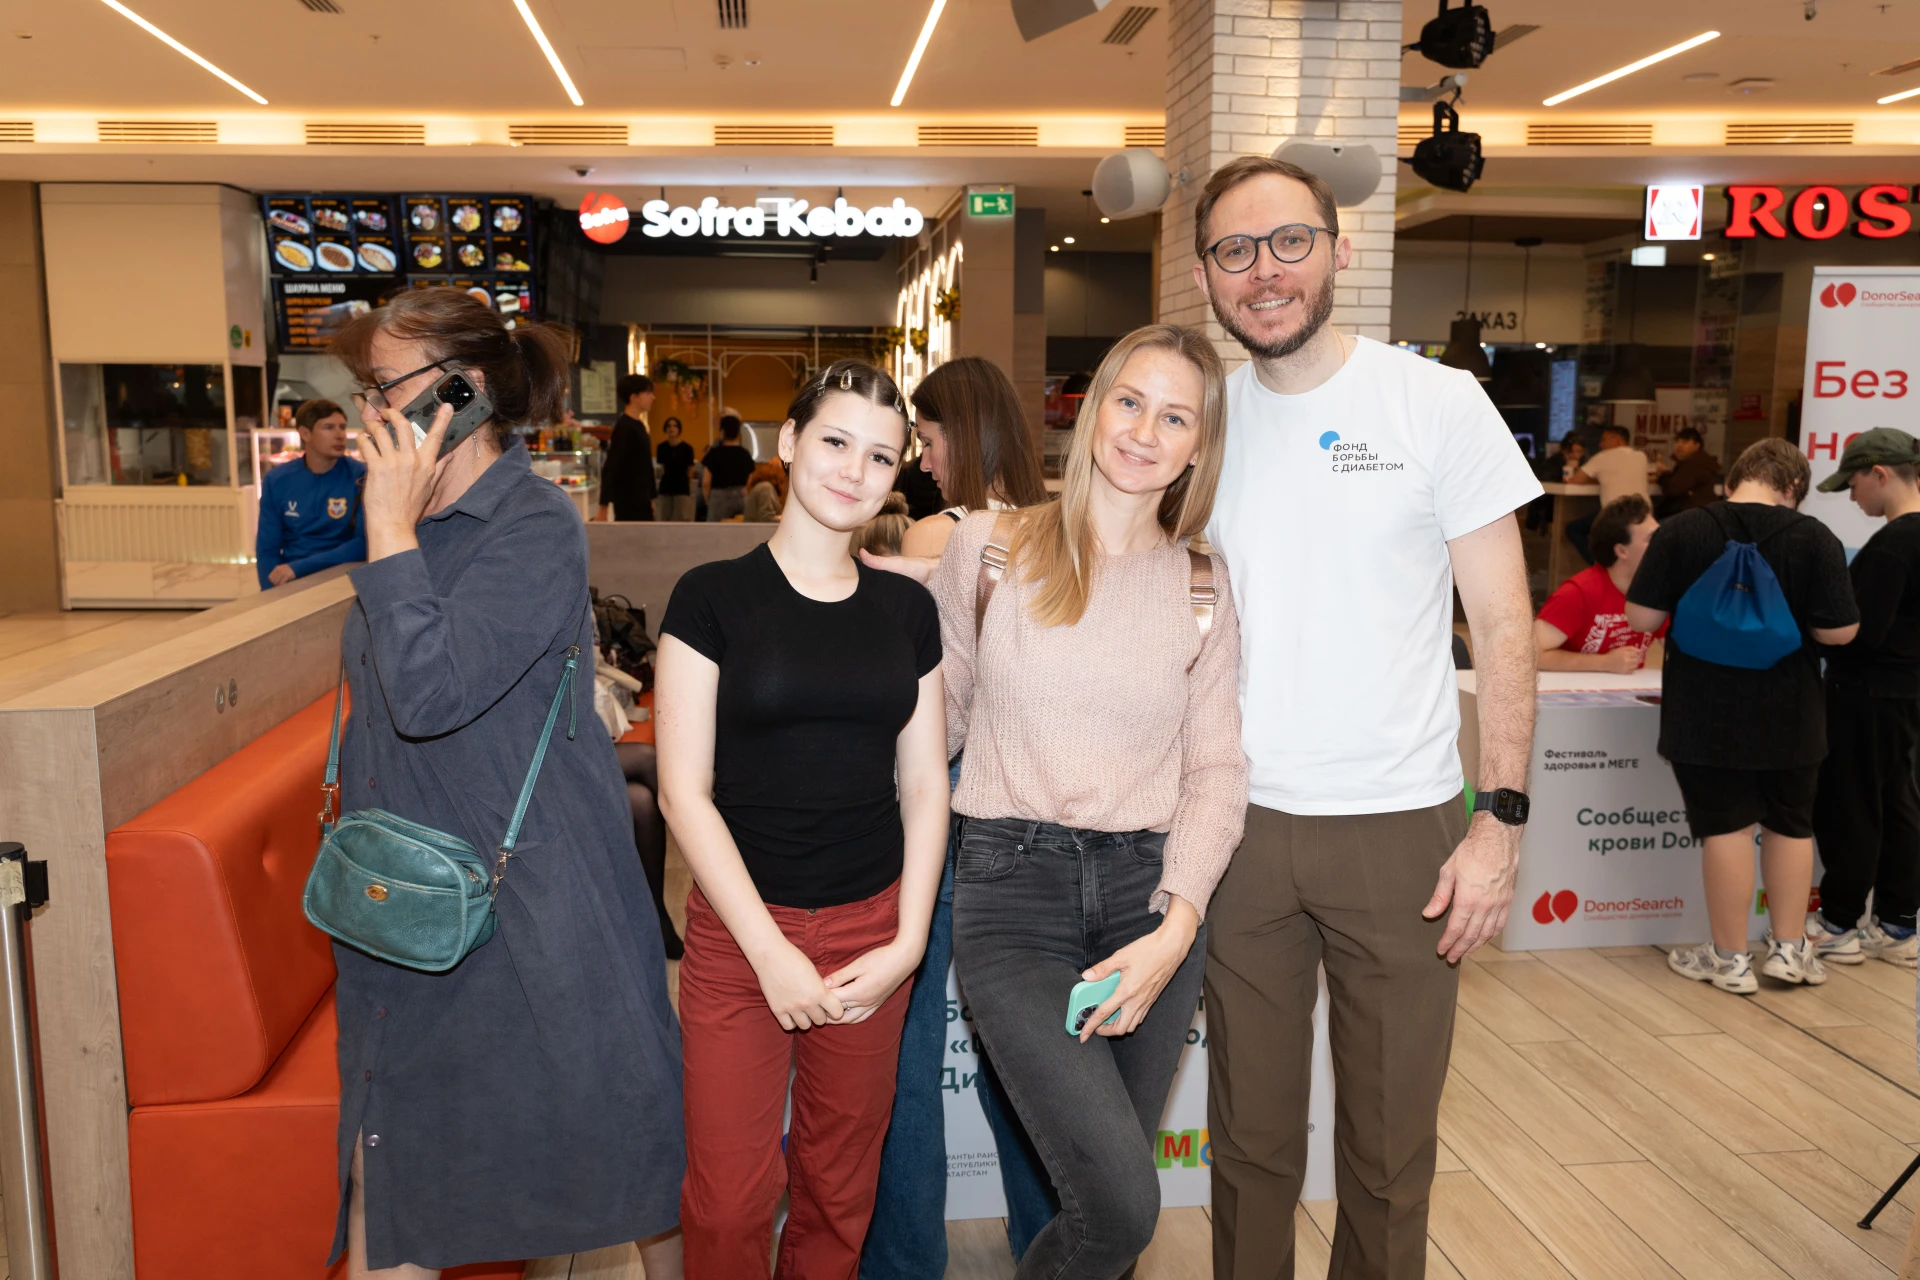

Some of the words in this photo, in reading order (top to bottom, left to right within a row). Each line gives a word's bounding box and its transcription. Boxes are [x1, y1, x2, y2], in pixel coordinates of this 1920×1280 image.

[579, 205, 629, 231] Sofra
[642, 197, 766, 238] Sofra
[776, 197, 925, 238] Kebab
[1725, 185, 1920, 239] ROS
[1813, 361, 1909, 399] Без
[1333, 443, 1368, 452] ФОНД
[1332, 453, 1378, 462] БОРЬБЫ
[1332, 464, 1339, 472] С
[1341, 463, 1404, 473] ДИАБЕТОМ
[1544, 749, 1608, 758] Фестиваль
[1543, 762, 1597, 771] здоровья
[1608, 759, 1639, 768] МЕГЕ
[1588, 835, 1655, 855] крови
[1584, 896, 1684, 913] DonorSearch
[946, 1169, 988, 1178] АТАРСТАН
